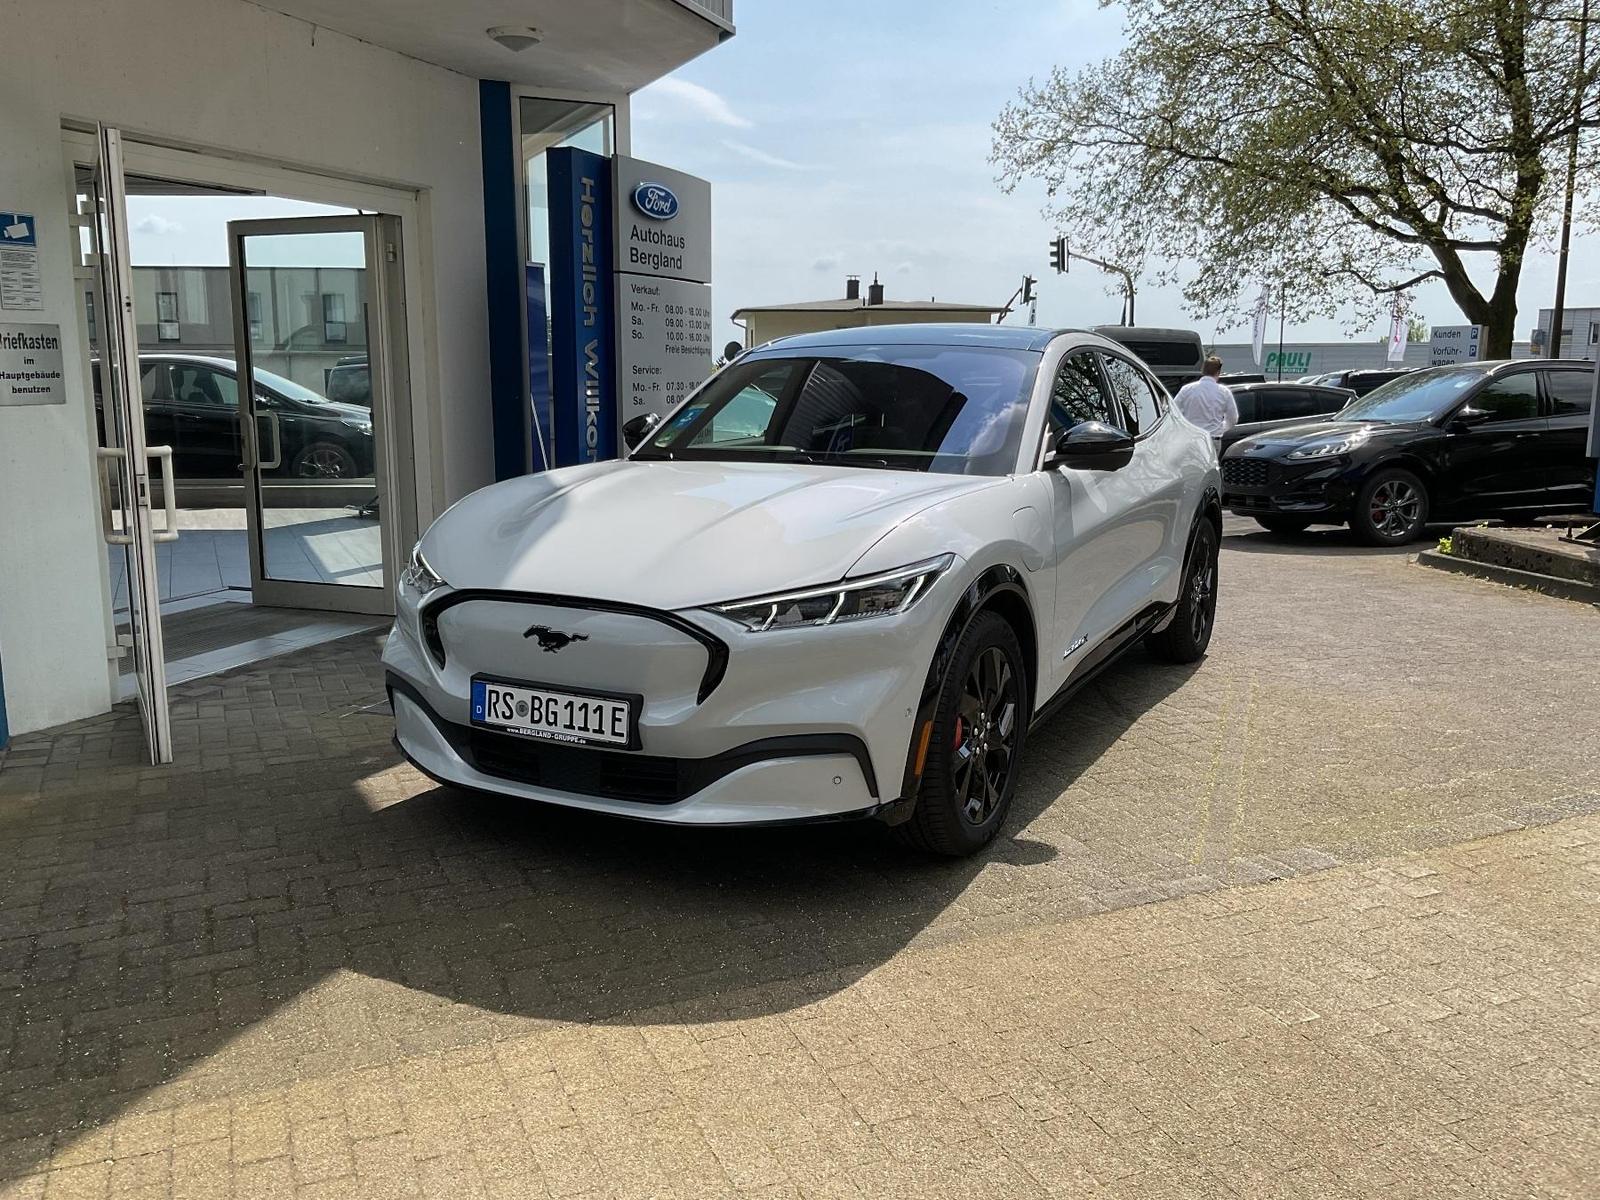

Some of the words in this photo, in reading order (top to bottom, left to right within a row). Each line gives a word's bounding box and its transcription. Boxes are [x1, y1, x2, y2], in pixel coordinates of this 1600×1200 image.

[645, 188, 672, 213] Ford
[630, 224, 685, 249] Autohaus
[630, 247, 682, 270] Bergland
[631, 315, 644, 325] Sa.
[631, 329, 645, 339] So.
[1433, 329, 1461, 339] Kunden
[23, 356, 35, 365] im
[1265, 351, 1312, 367] PAULI
[632, 364, 662, 375] Service:
[0, 371, 60, 381] Hauptgebäude
[12, 385, 51, 394] benutzen
[633, 396, 646, 406] Sa.
[488, 690, 514, 720] RS
